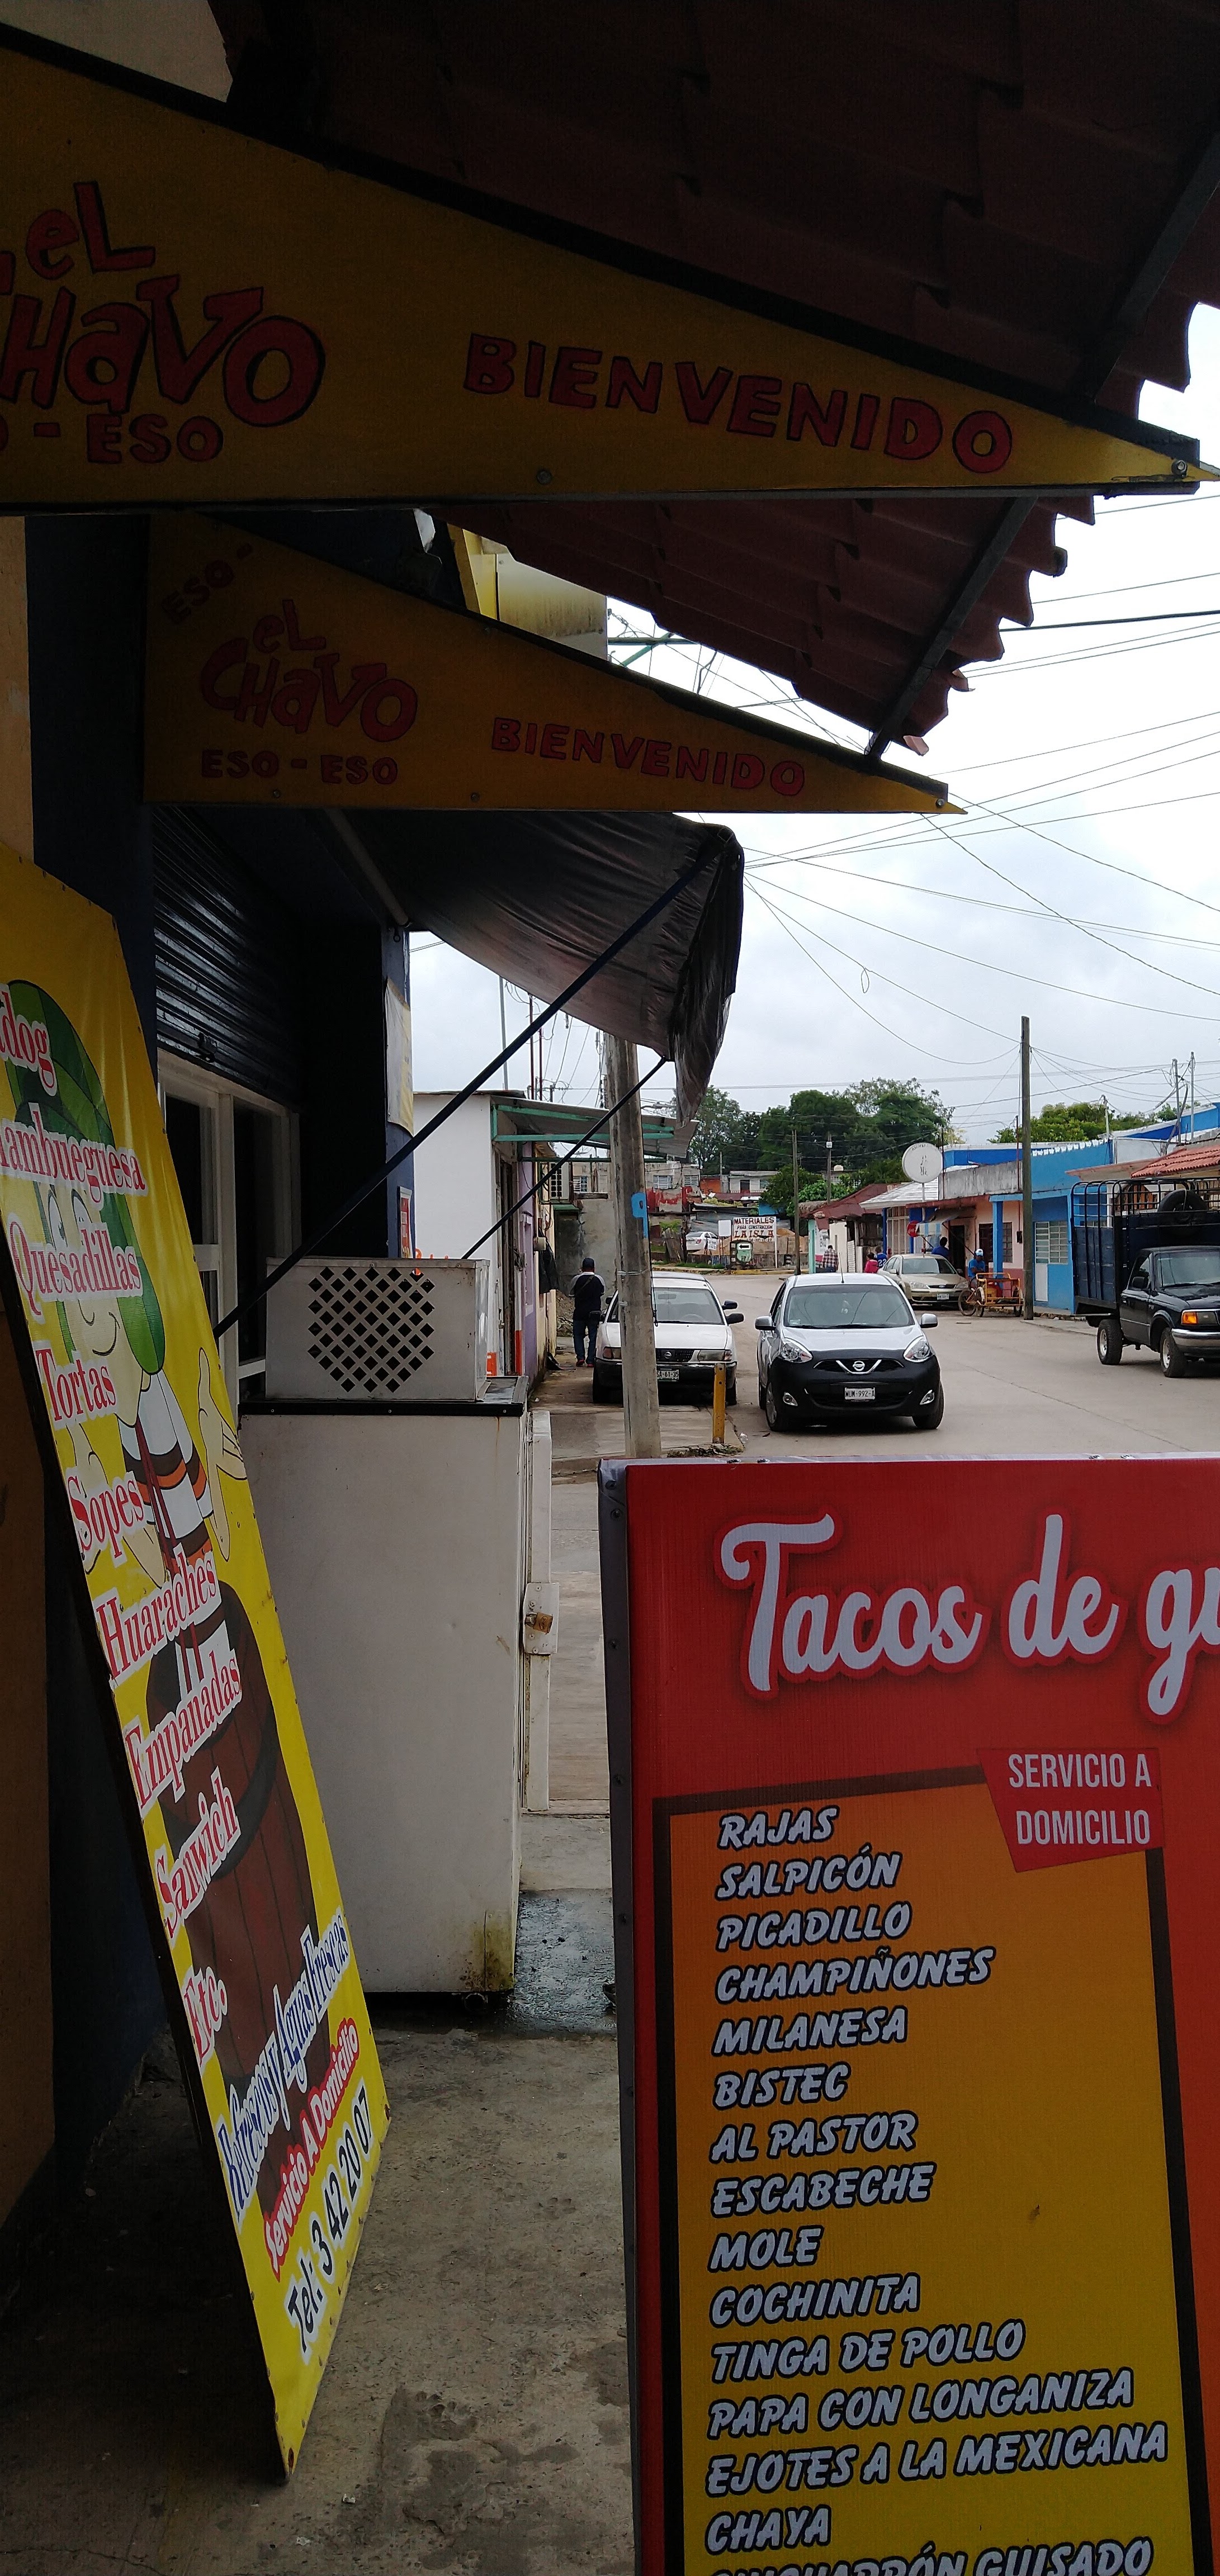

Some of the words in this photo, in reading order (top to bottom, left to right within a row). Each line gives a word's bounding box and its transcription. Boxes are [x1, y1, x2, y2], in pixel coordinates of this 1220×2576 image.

[0, 251, 326, 428] HaVO
[463, 333, 1013, 473] BIENVENIDO
[86, 413, 224, 463] ESO
[162, 560, 235, 624] ESO
[201, 749, 279, 778] ESO
[320, 755, 398, 785] ESO
[492, 718, 804, 795] BIENVENIDO
[0, 991, 54, 1088] dog
[0, 1111, 145, 1203] ambueguesa
[9, 1222, 141, 1315] Quesadillas
[36, 1348, 116, 1422] Tortas
[68, 1476, 144, 1557] Sopes
[97, 1553, 216, 1677] Huaraches
[721, 1512, 982, 1692] Tacos
[1008, 1513, 1119, 1659] de
[125, 1652, 240, 1808] Empanadas
[1009, 1753, 1126, 1789] SERVICIO
[1134, 1752, 1152, 1788] A
[157, 1778, 238, 1938] Sanwich
[719, 1807, 836, 1848] RAJAS
[1016, 1810, 1150, 1845] DOMICILIO
[717, 1845, 902, 1898] SALPICÓN
[717, 1902, 912, 1950] PICADILLO
[716, 1945, 995, 2002] CHAMPIÑONES
[184, 1974, 226, 2066] Etc.
[713, 2007, 906, 2054] MILANESA
[217, 2063, 278, 2217] Refrescos
[275, 1993, 314, 2085] Aguas
[303, 1915, 349, 2014] Frescas
[714, 2063, 850, 2108] BISTEC
[266, 2151, 306, 2271] Servicio
[302, 2119, 318, 2166] A
[310, 2024, 358, 2133] Domicilio
[710, 2125, 757, 2162] AL
[769, 2112, 917, 2156] PASTOR
[289, 2259, 323, 2352] Tel:
[313, 2220, 333, 2276] 3
[324, 2171, 348, 2242] 42
[339, 2130, 361, 2202] 20
[353, 2085, 373, 2156] 07
[712, 2163, 936, 2215] ESCABECHE
[709, 2227, 822, 2271] MOLE
[711, 2275, 919, 2326] COCHINITA
[712, 2338, 827, 2383] TINGA
[840, 2331, 893, 2371] DE
[902, 2320, 1024, 2366] POLLO
[708, 2397, 806, 2438] PAPA
[820, 2387, 902, 2430] CON
[912, 2369, 1133, 2422] LONGANIZA
[706, 2447, 858, 2495] EJOTES
[862, 2445, 889, 2482] A
[900, 2440, 945, 2479] LA
[956, 2423, 1167, 2474] MEXICANA
[706, 2506, 830, 2553] CHAYA
